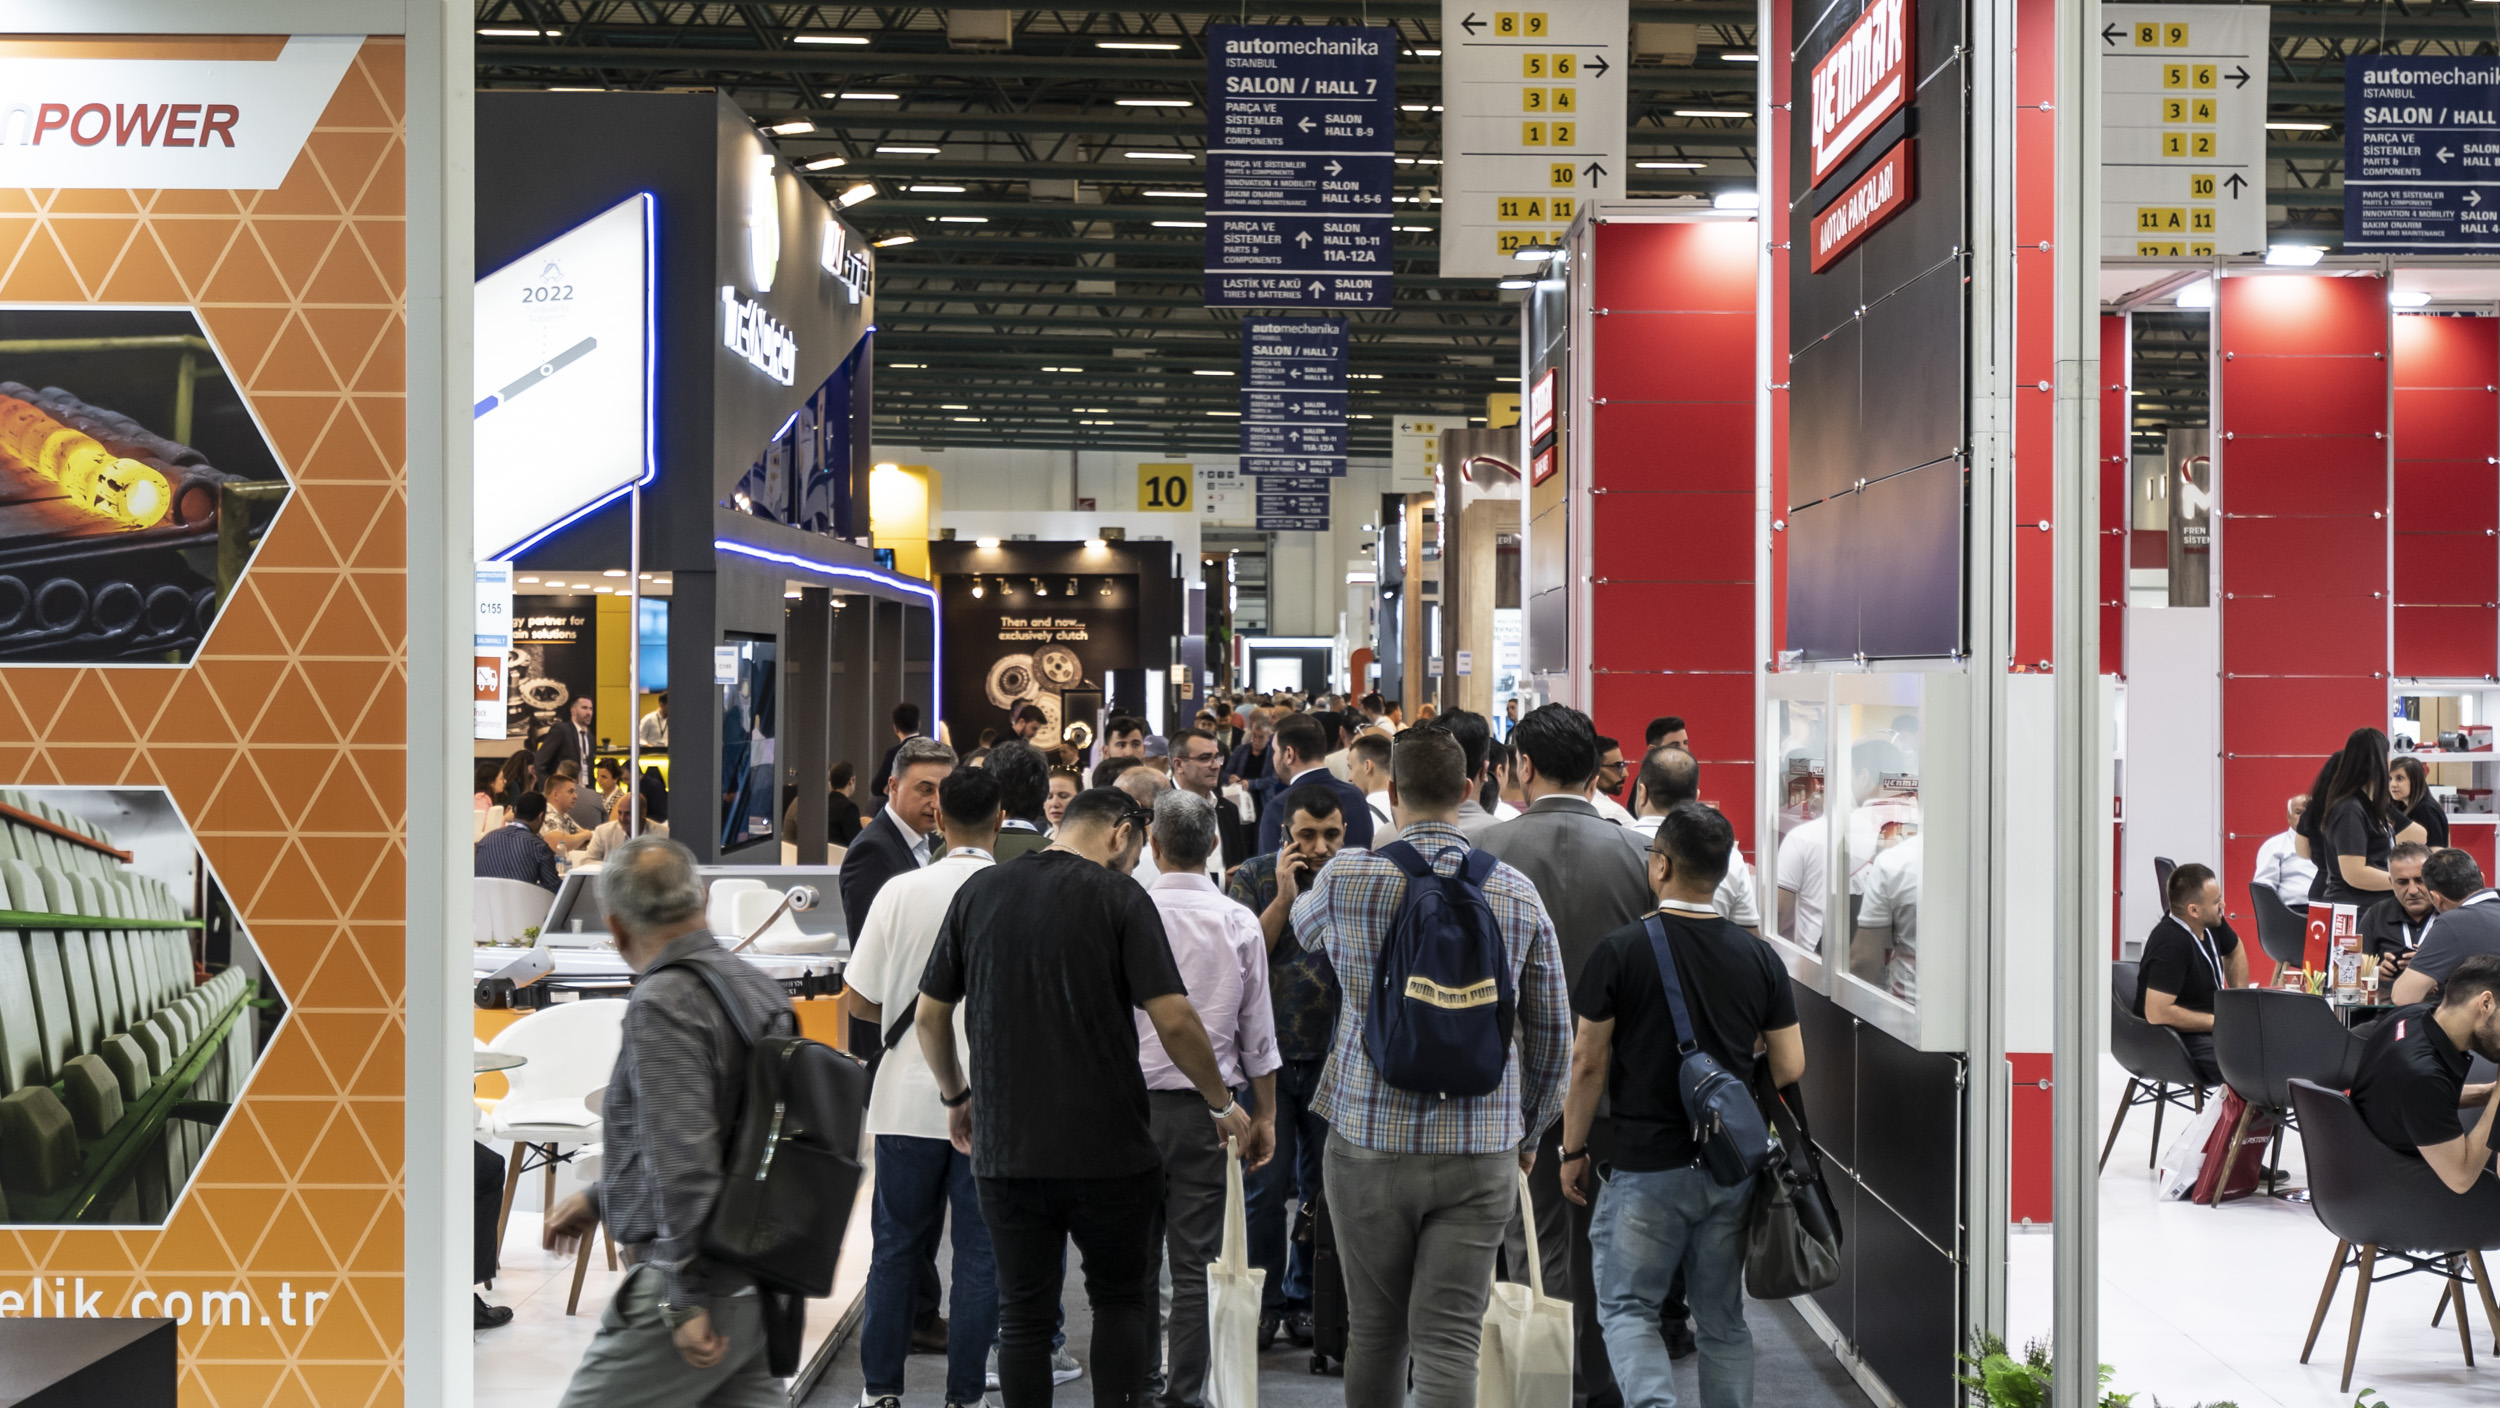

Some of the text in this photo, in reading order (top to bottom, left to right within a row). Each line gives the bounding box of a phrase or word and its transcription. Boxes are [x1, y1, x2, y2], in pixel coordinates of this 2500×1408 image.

[1502, 18, 1541, 32] 8 9
[2142, 28, 2182, 42] 8 9
[1226, 38, 1378, 55] automechanika
[1226, 58, 1278, 69] ISTANBUL
[1531, 59, 1569, 74] 5 6
[2171, 70, 2210, 84] 5 6
[1226, 77, 1378, 95] SALON / HALL 7
[2364, 88, 2415, 98] ISTANBUL
[1531, 94, 1569, 108] 3 4
[1225, 102, 1277, 114] PARÇA VE
[2170, 104, 2210, 118] 3 4
[1225, 114, 1284, 126] SİSTEMLER
[1325, 114, 1362, 124] SALON
[2364, 107, 2496, 124] SALON / HALL
[1325, 128, 1374, 136] HALL 8-9
[1531, 128, 1568, 142] 1 2
[2171, 138, 2208, 152] 1 2
[2364, 134, 2415, 144] PARÇA VE
[2364, 145, 2421, 156] SİSTEMLER
[2464, 144, 2500, 154] SALON
[2464, 157, 2491, 166] HALL
[1554, 168, 1572, 183] 10
[2363, 168, 2422, 176] COMPONENTS
[1322, 181, 1360, 190] SALON
[2195, 180, 2213, 194] 10
[1322, 194, 1381, 204] HALL 4-5-6
[1501, 202, 1540, 216] 11 A
[1554, 202, 1572, 216] 11
[1820, 161, 1894, 255] MOTOR PARÇALARI
[2142, 213, 2180, 227] 11 A
[2194, 214, 2212, 228] 11
[2461, 211, 2498, 220] SALON
[1224, 222, 1276, 232] PARÇA VE
[1324, 223, 1360, 232] SALON
[2461, 224, 2489, 234] HALL
[1323, 236, 1380, 246] HALL 10-11
[1501, 236, 1518, 250] 12
[1324, 250, 1376, 262] 11A-12A
[1223, 278, 1260, 288] LASTİK
[1262, 280, 1276, 288] VE
[1335, 279, 1372, 288] SALON
[522, 284, 574, 304] 2022
[1335, 292, 1374, 301] HALL 7
[1252, 323, 1340, 334] automechanika
[1252, 345, 1292, 356] SALON
[1302, 348, 1328, 356] HALL
[1332, 346, 1338, 356] 7
[1146, 476, 1187, 508] 10
[2184, 527, 2206, 535] FREN
[480, 602, 502, 614] C155
[528, 616, 566, 628] partner
[570, 616, 584, 626] for
[1000, 616, 1028, 627] Then
[1031, 616, 1052, 627] and
[532, 628, 577, 639] solutions
[998, 630, 1088, 643] exclusively clutch
